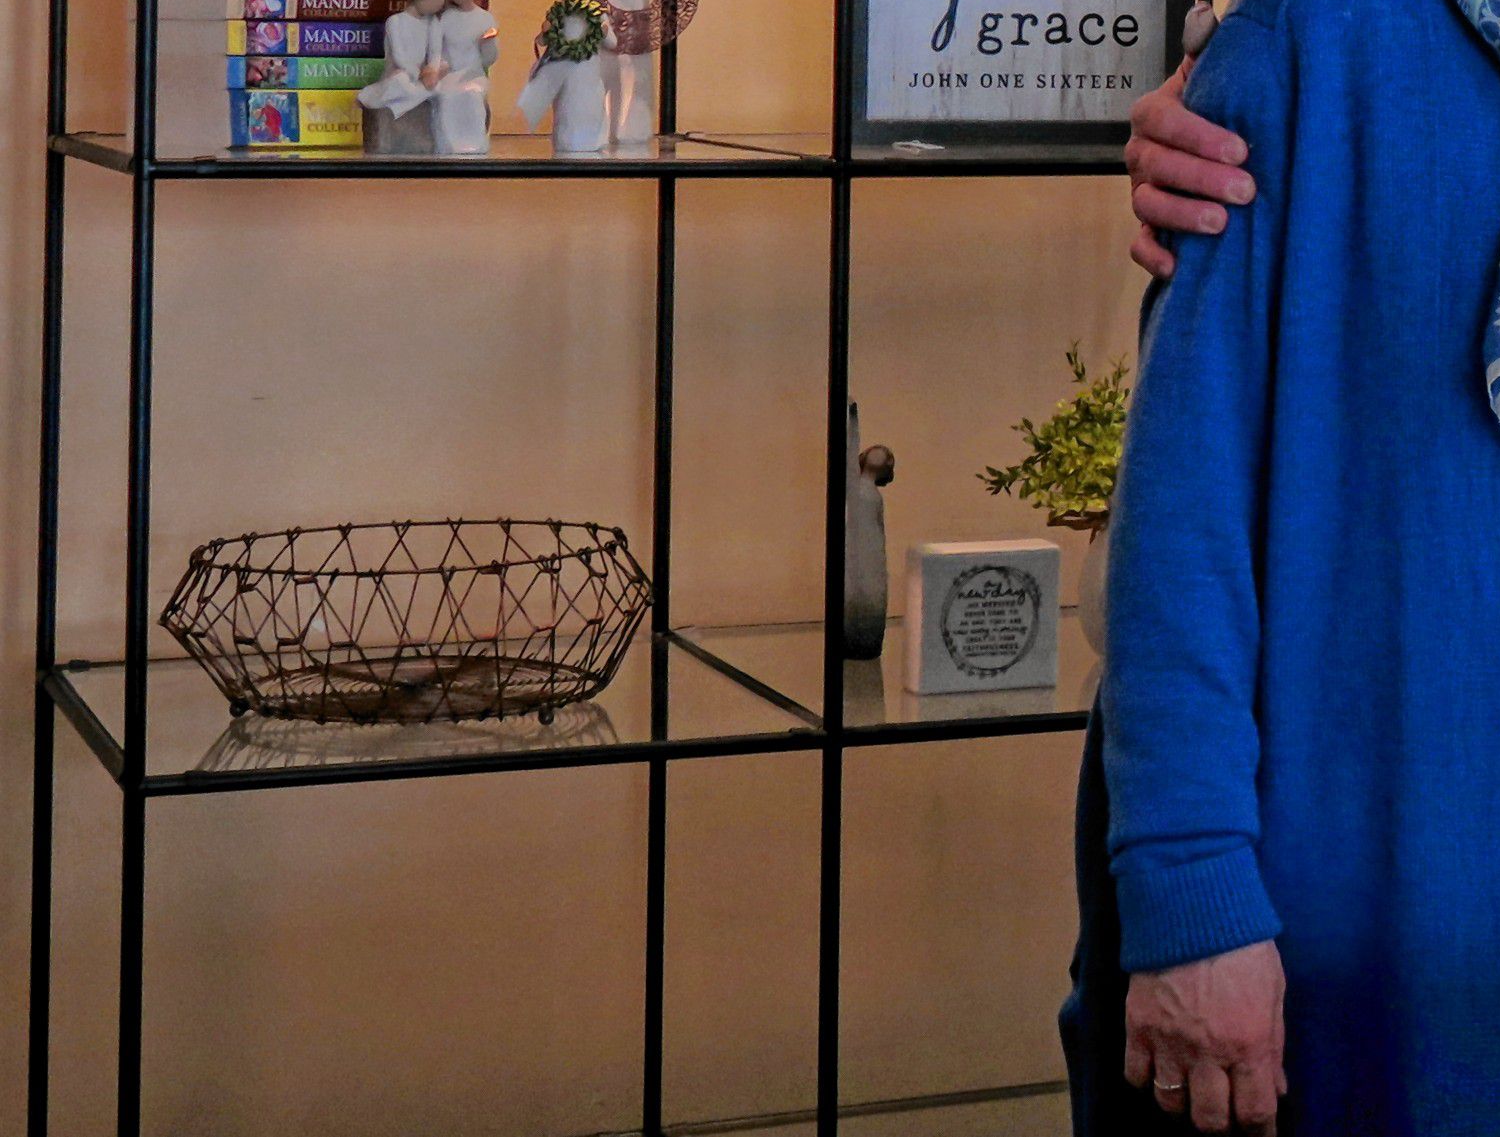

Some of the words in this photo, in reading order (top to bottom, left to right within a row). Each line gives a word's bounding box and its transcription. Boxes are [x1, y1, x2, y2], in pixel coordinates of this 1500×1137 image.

[304, 29, 371, 45] MANDIE
[976, 13, 1139, 55] grace
[304, 63, 369, 78] MANDIE
[908, 73, 969, 88] JOHN
[980, 73, 1025, 88] ONE
[1036, 74, 1134, 89] SIXTEEN
[307, 122, 360, 133] COLLECT
